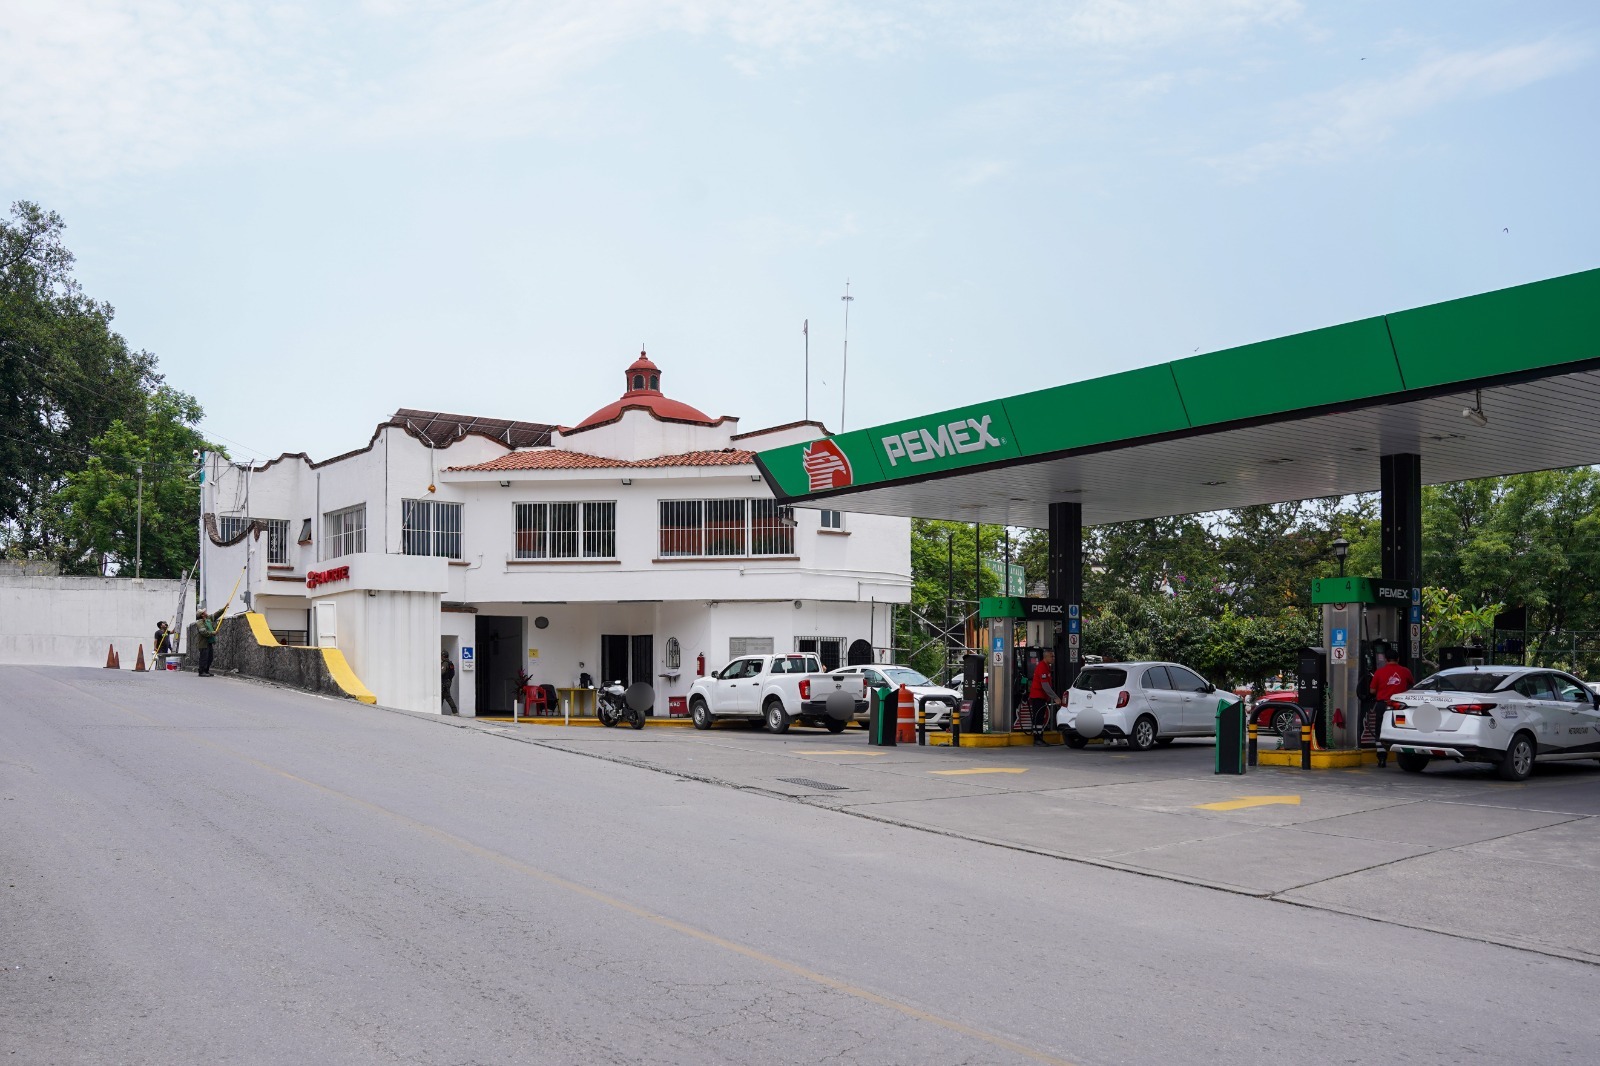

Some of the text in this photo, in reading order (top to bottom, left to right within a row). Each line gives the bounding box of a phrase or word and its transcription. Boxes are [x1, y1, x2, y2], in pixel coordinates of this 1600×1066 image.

[882, 415, 1000, 466] PEMEX
[1315, 580, 1352, 593] 3 4
[1379, 588, 1408, 598] PEMEX
[998, 600, 1003, 609] 2
[1011, 600, 1016, 609] 2
[1032, 604, 1062, 613] PEMEX
